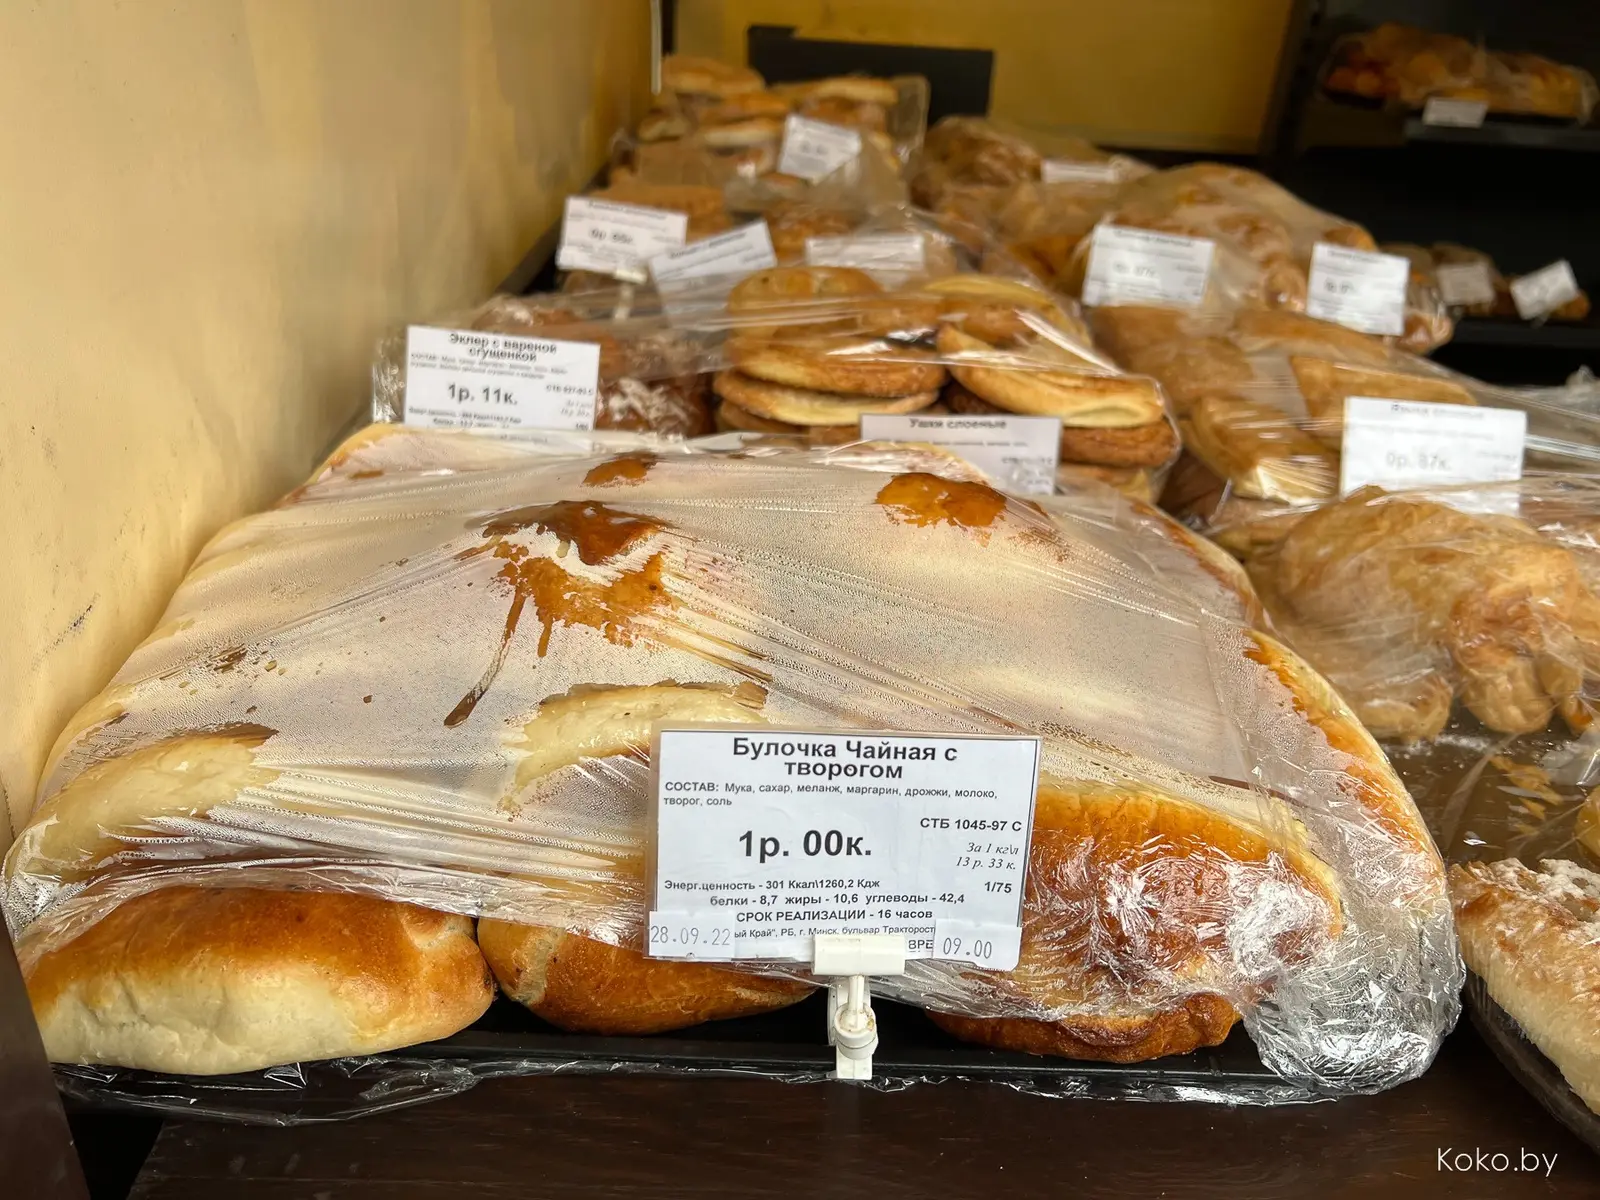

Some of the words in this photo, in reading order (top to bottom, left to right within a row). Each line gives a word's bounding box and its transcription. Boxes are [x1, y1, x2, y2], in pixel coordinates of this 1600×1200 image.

[450, 333, 489, 348] Эклер
[492, 340, 500, 348] с
[504, 339, 557, 354] вареной
[469, 347, 537, 361] сгущенкой
[448, 383, 475, 404] 1р.
[482, 386, 518, 405] 11к.
[733, 737, 837, 760] Булочка
[846, 740, 936, 761] Чайная
[944, 747, 958, 761] с
[784, 761, 903, 780] творогом
[665, 781, 720, 792] СОСТАВ:
[725, 782, 755, 794] Мука,
[759, 784, 793, 794] сахар,
[797, 785, 843, 794] меланж,
[846, 786, 902, 797] маргарин,
[905, 788, 951, 798] дрожжи,
[955, 789, 998, 799] молоко,
[663, 797, 703, 807] творог,
[706, 798, 732, 806] соль
[920, 817, 950, 829] СТБ
[955, 819, 1008, 831] 1045-97
[1012, 821, 1022, 832] С
[739, 830, 790, 864] 1р.
[803, 829, 872, 856] 00к.
[967, 842, 982, 853] За
[986, 843, 992, 853] 1
[956, 857, 971, 867] 13
[972, 859, 984, 870] р.
[988, 858, 1003, 869] 33
[664, 880, 756, 891] Энерг.ценность
[766, 880, 784, 890] 301
[788, 879, 854, 891] Ккал\1260,2
[857, 879, 880, 889] Кдж
[984, 881, 1012, 894] 1/75
[710, 896, 748, 906] белки
[760, 894, 778, 907] 8,7
[785, 895, 822, 906] жиры
[834, 893, 858, 905] 10,6
[865, 894, 928, 904] углеводы
[939, 893, 965, 904] 42,4
[736, 911, 773, 922] СРОК
[776, 909, 866, 922] РЕАЛИЗАЦИИ
[878, 909, 891, 919] 16
[895, 909, 933, 919] часов
[651, 925, 731, 946] 28.09.22
[841, 926, 880, 936] бульвар
[942, 937, 992, 959] 09.00
